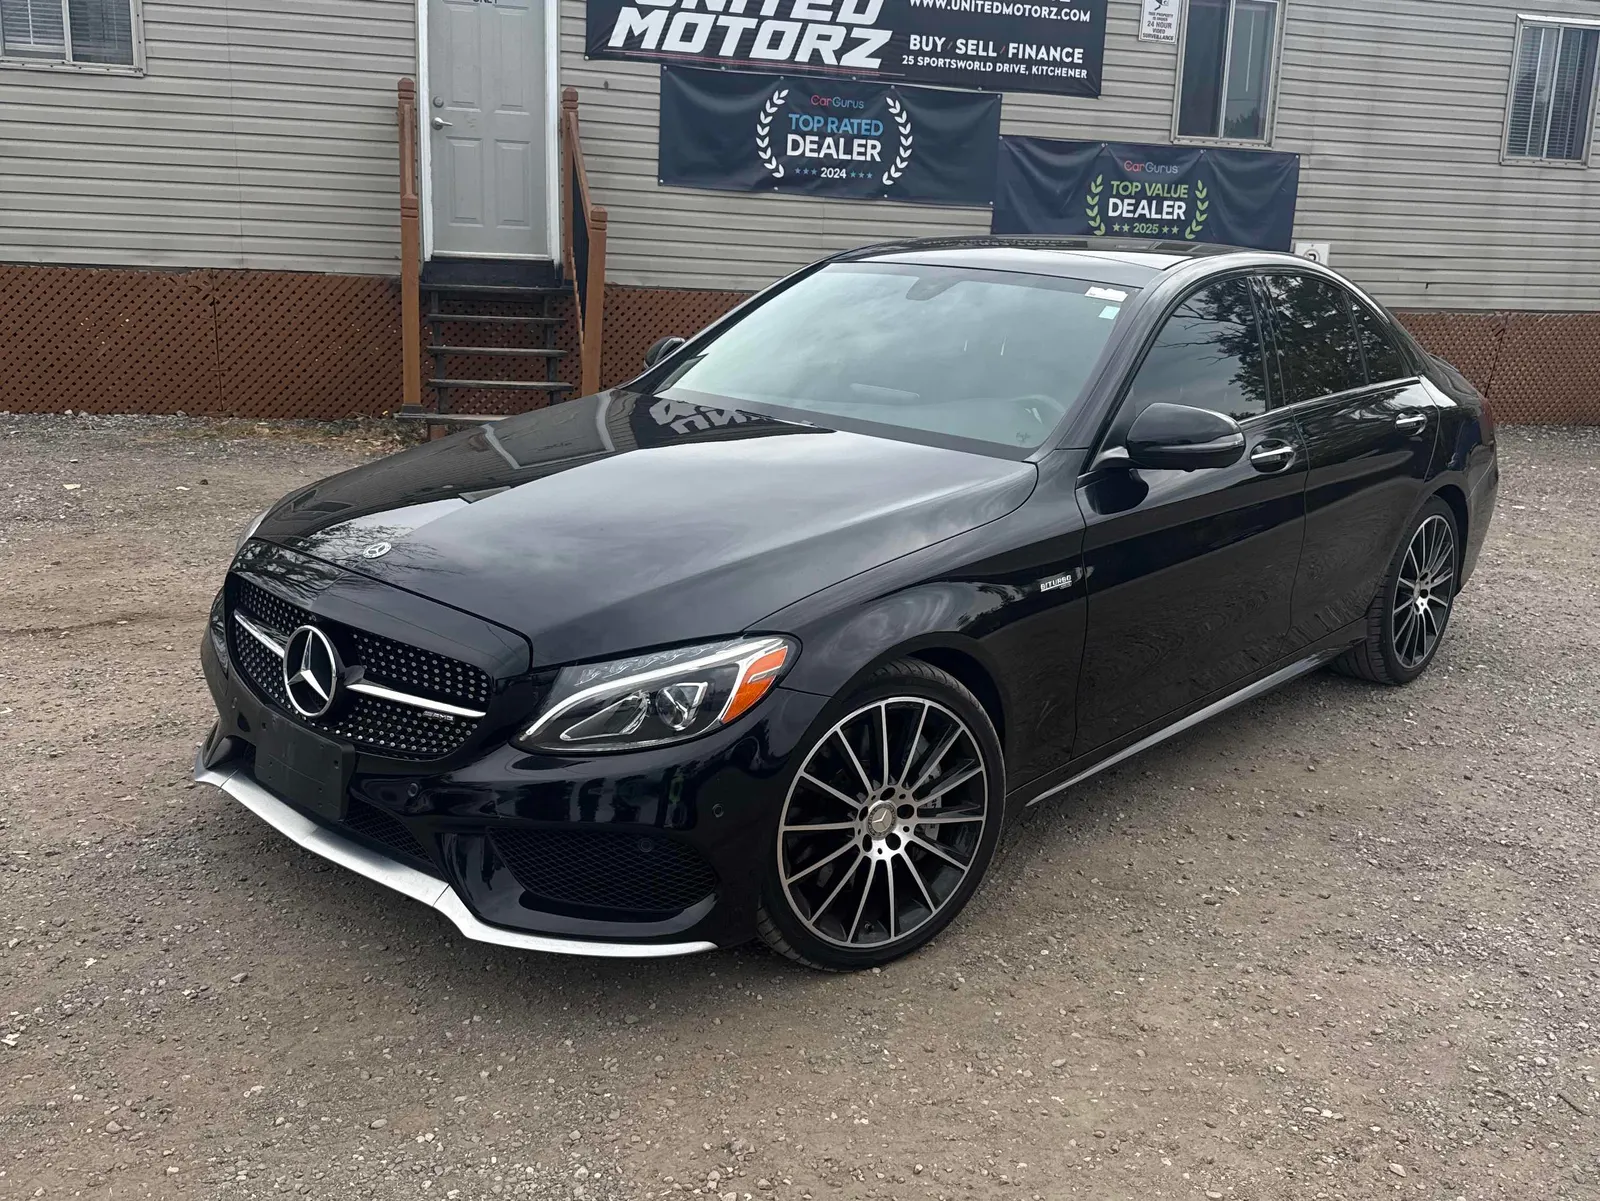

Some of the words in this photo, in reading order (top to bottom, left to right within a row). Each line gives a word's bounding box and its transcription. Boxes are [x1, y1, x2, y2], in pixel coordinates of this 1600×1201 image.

[1156, 21, 1172, 29] HOUR
[608, 6, 893, 69] MOTORZ
[909, 34, 946, 53] BUY
[955, 38, 998, 57] SELL
[1008, 42, 1084, 64] FINANCE
[902, 55, 915, 65] 25
[917, 56, 993, 72] SPORTSWORLD
[996, 62, 1029, 75] DRIVE,
[1031, 65, 1088, 79] KITCHENER
[810, 94, 865, 109] CarGurus
[788, 113, 824, 132] TOP
[827, 117, 884, 137] RATED
[786, 133, 882, 162] DEALER
[820, 167, 847, 179] 2024
[1124, 160, 1179, 174] CarGurus
[1110, 181, 1141, 196] TOP
[1145, 182, 1189, 199] VALUE
[1108, 197, 1187, 220] DEALER
[1133, 223, 1159, 234] 2025
